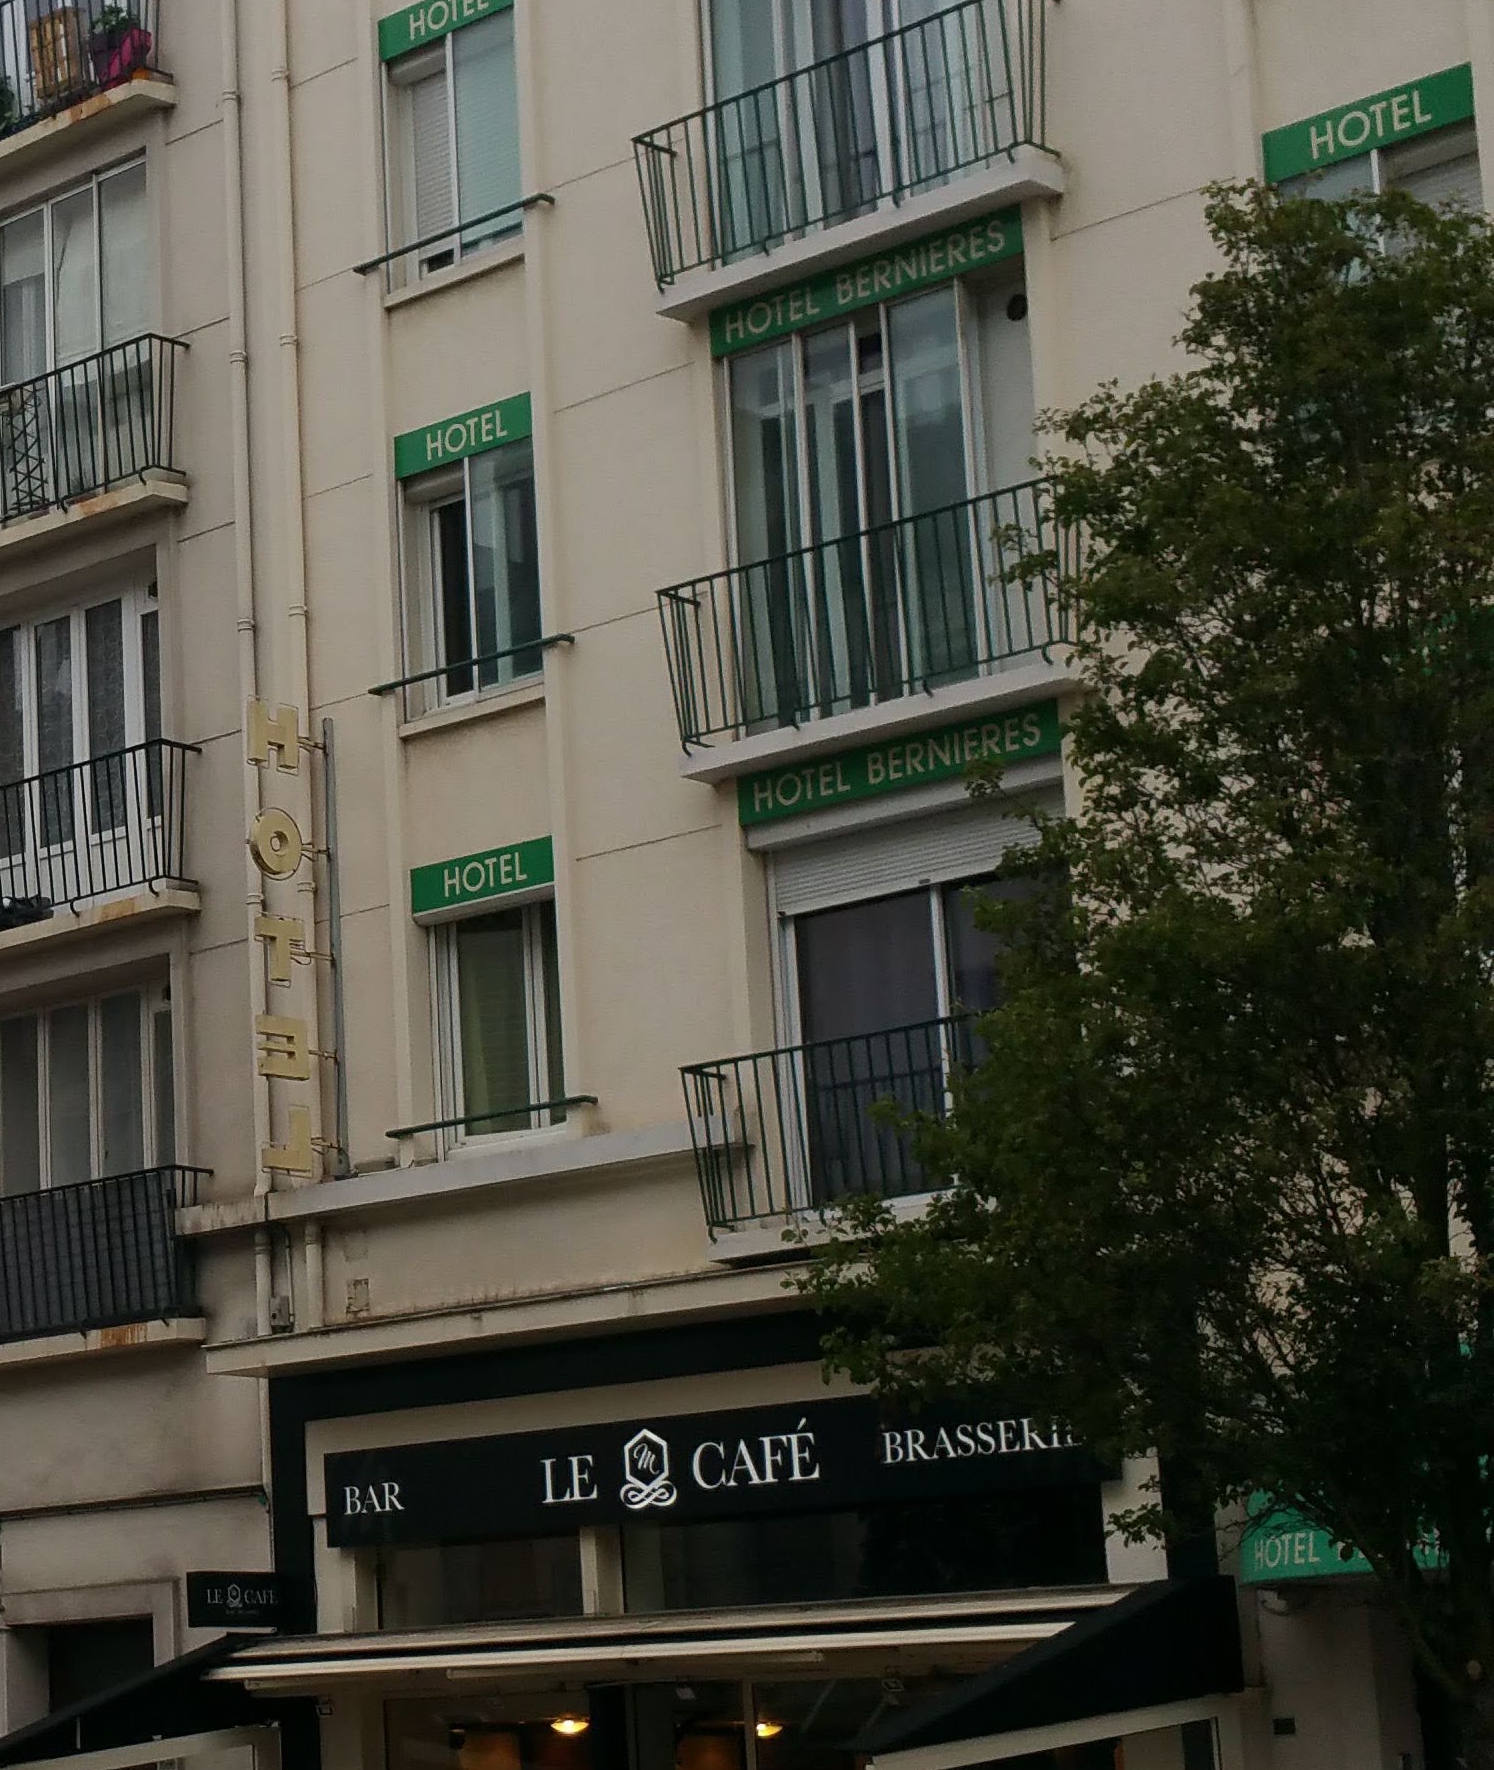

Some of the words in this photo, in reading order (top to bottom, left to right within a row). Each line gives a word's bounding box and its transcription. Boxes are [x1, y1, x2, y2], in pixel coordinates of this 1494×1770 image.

[1309, 90, 1432, 160] HOTEL
[724, 287, 821, 344] HOTEL
[835, 220, 1007, 306] BERNIERES
[426, 409, 509, 461] HOTEL
[753, 761, 851, 813] HOTEL
[866, 713, 1042, 785] BERNIERES
[443, 851, 528, 898] HOTEL
[540, 1454, 598, 1505] LE
[692, 1417, 821, 1490] CAFÉ
[343, 1481, 406, 1516] BAR
[1254, 1531, 1320, 1572] HOTEL
